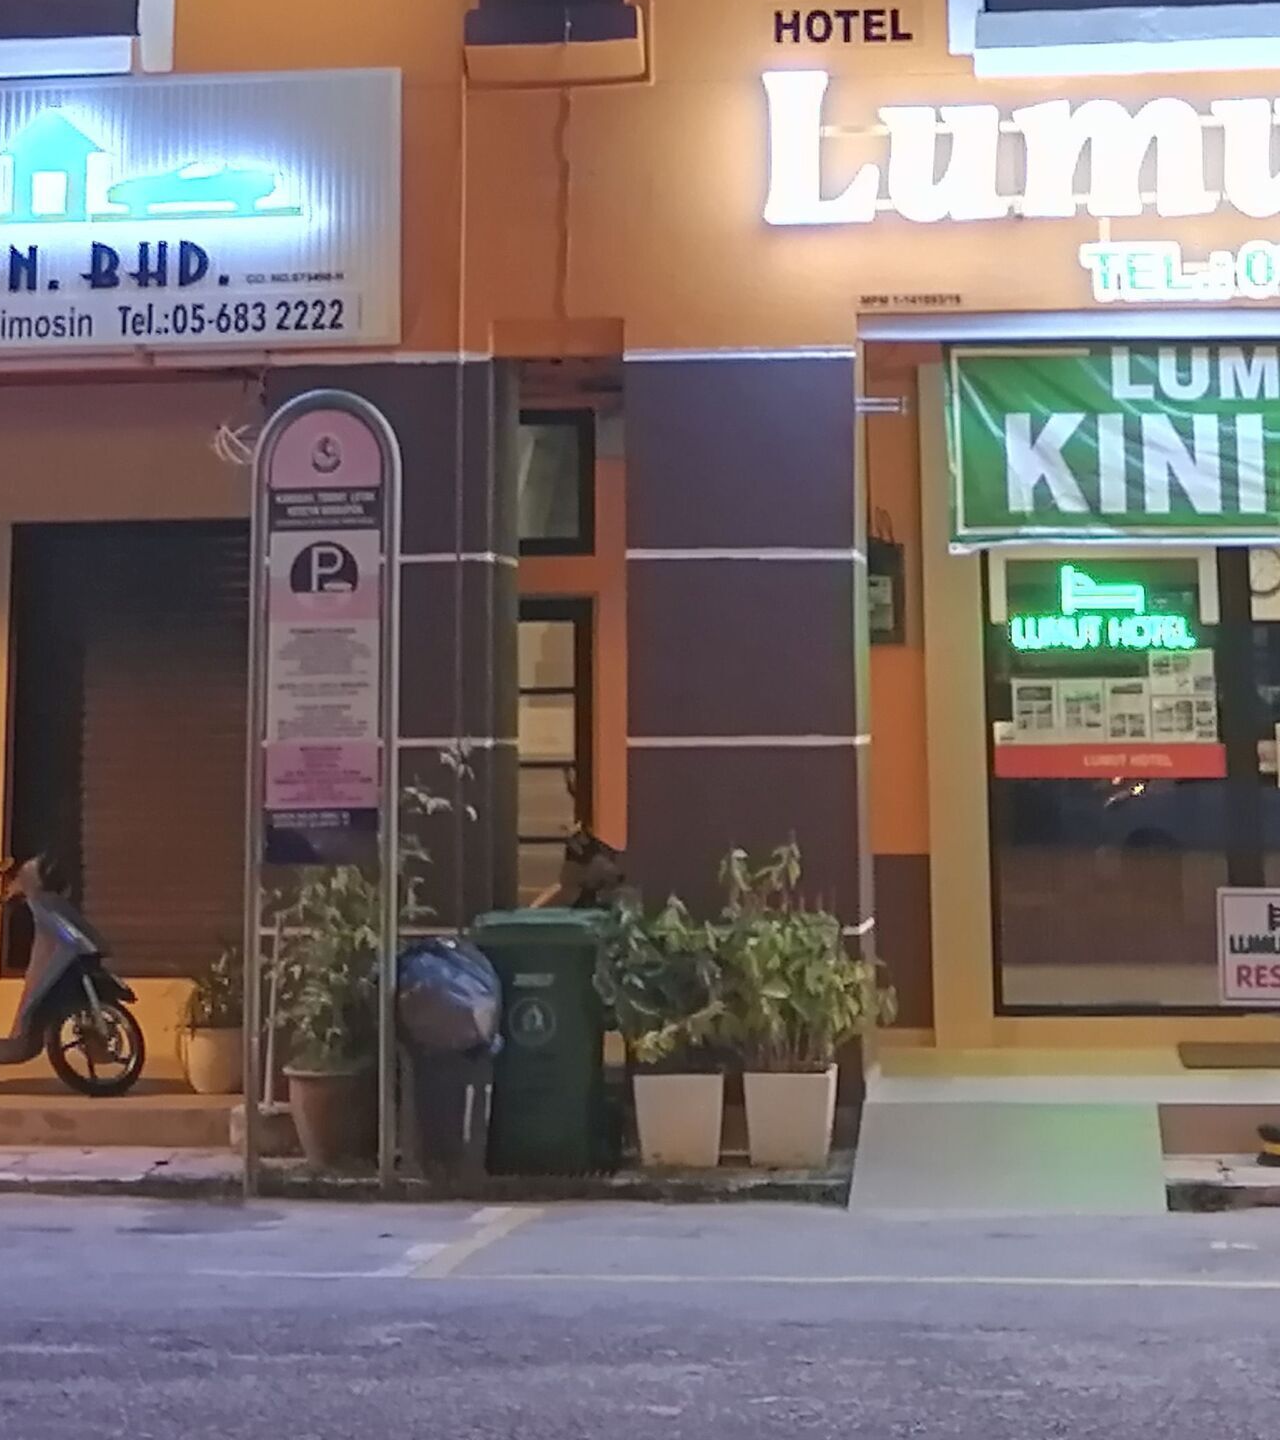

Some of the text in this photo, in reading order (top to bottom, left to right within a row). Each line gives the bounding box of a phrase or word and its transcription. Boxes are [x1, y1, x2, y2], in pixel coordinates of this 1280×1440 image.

[772, 9, 916, 46] HOTEL
[80, 240, 232, 290] BHD.
[274, 297, 345, 333] 2222
[1002, 409, 1266, 517] KINI
[1010, 614, 1197, 650] LUMUT HOTEL
[1083, 753, 1173, 767] LUMUT HOTEL
